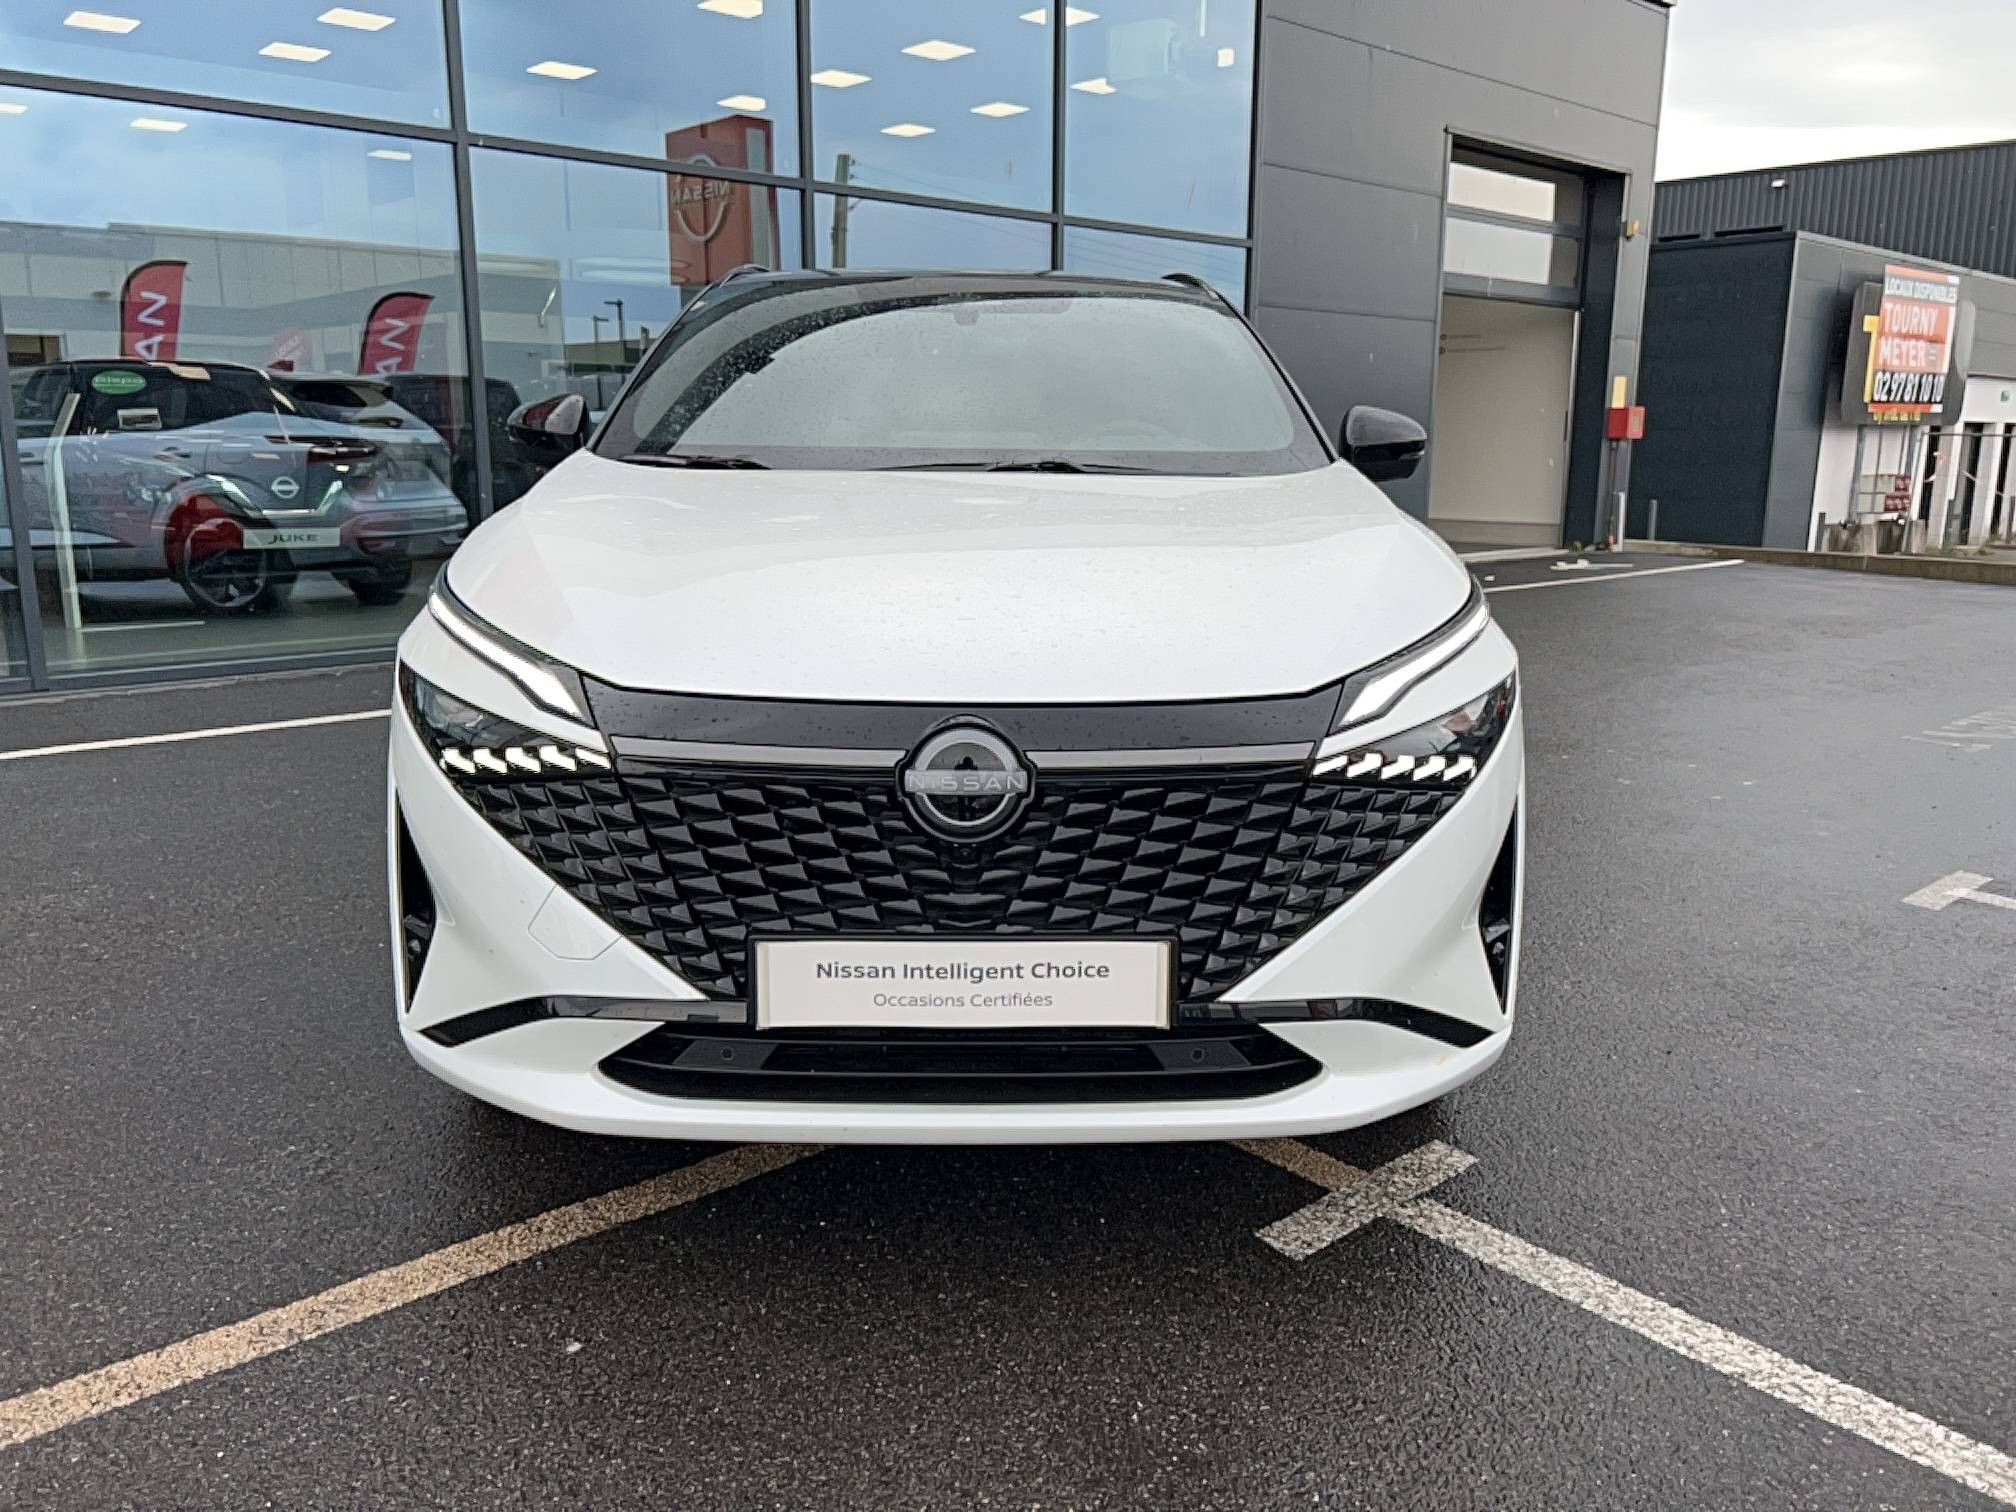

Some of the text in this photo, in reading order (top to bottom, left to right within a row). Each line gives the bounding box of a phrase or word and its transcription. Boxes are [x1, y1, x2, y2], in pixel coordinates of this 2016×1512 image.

[1884, 303, 1938, 337] TOURNY
[1879, 336, 1926, 367] MEYER
[1873, 371, 1945, 402] 02 97 81 10 10
[267, 533, 318, 545] JUKE
[909, 775, 1024, 792] NISSAN
[816, 961, 1110, 984] Nissan Intelligent Choice
[873, 992, 1053, 1008] Occasions Certifiées
